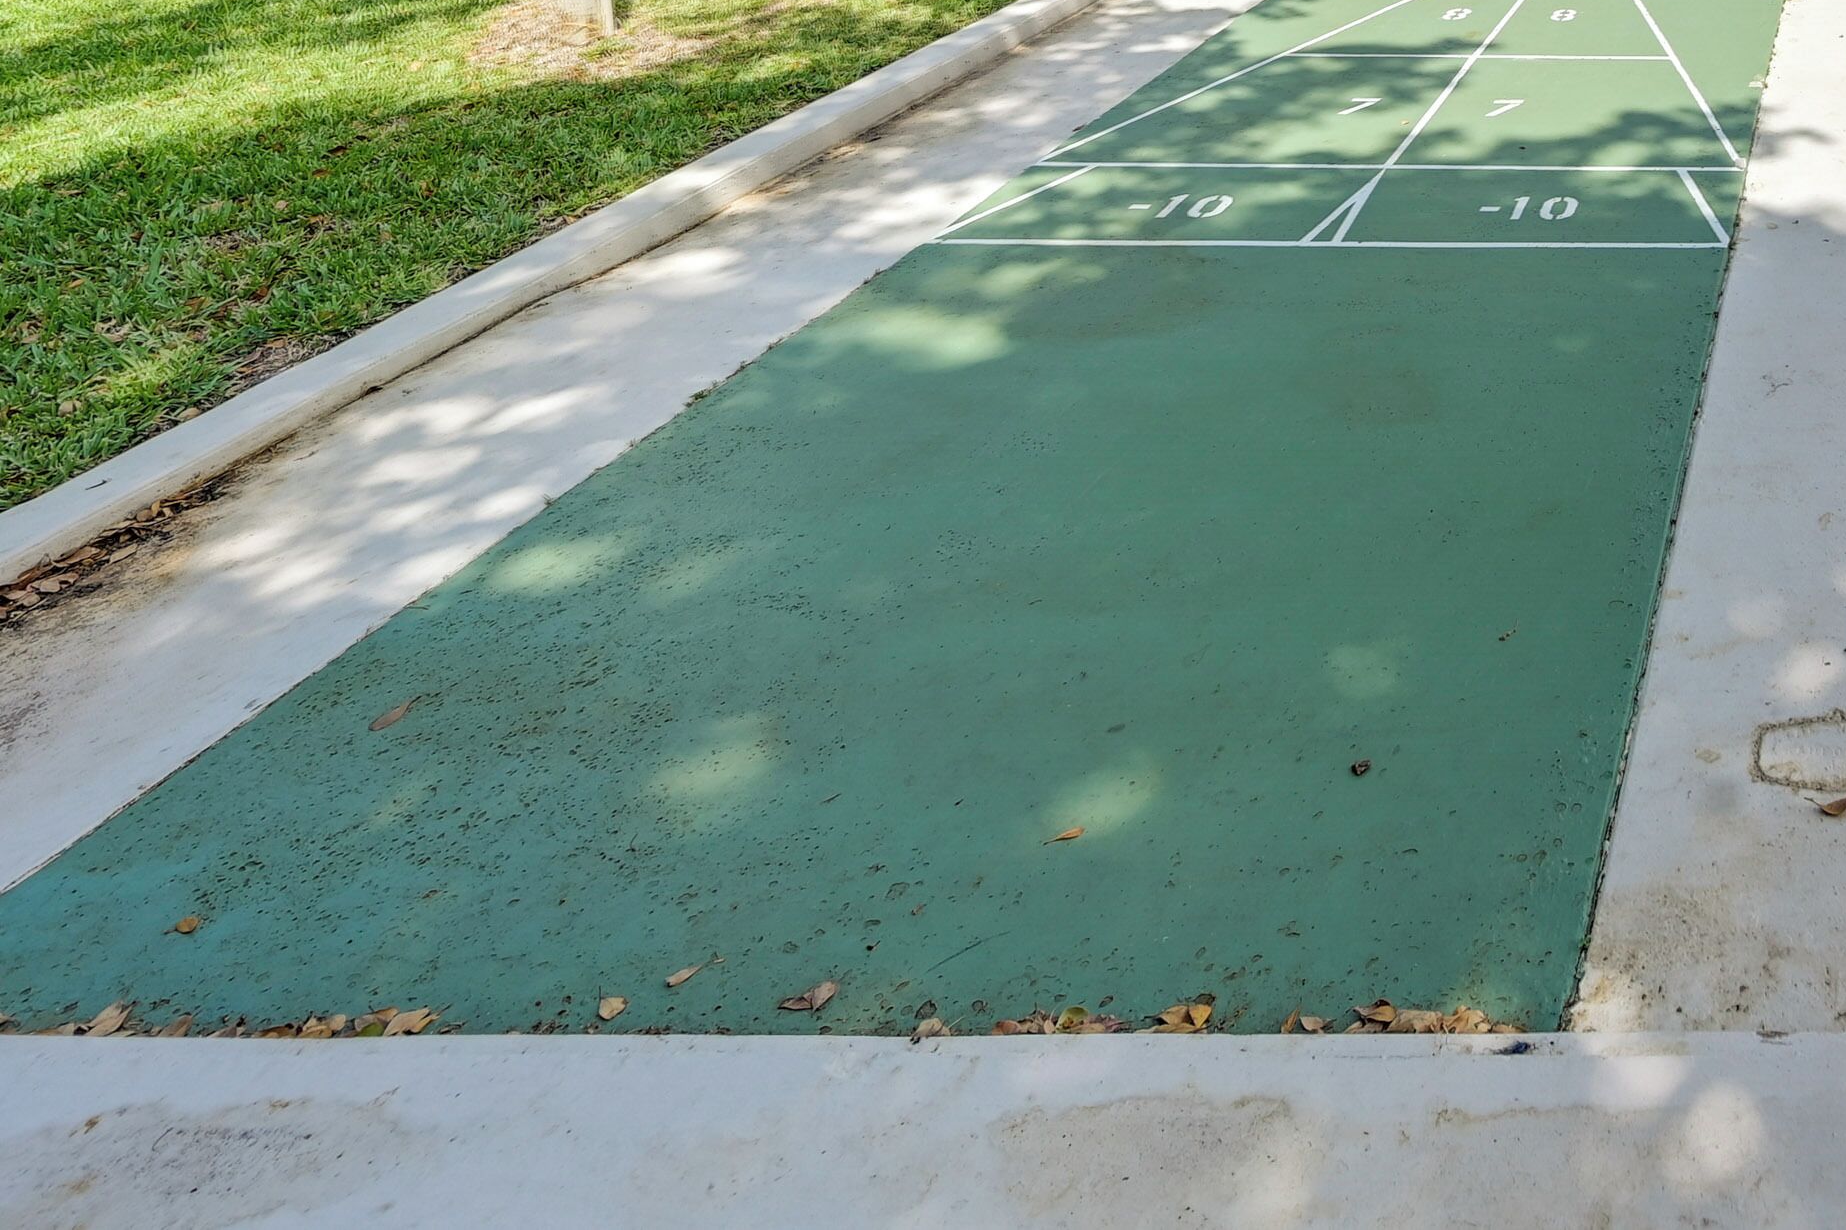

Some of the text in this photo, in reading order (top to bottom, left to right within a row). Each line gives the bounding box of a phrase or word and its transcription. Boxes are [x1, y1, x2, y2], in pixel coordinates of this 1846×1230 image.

[1441, 8, 1473, 21] 8
[1550, 9, 1577, 22] 8
[1337, 97, 1381, 115] 7
[1485, 99, 1525, 117] 7
[1127, 194, 1234, 219] -10
[1479, 196, 1579, 221] -10
